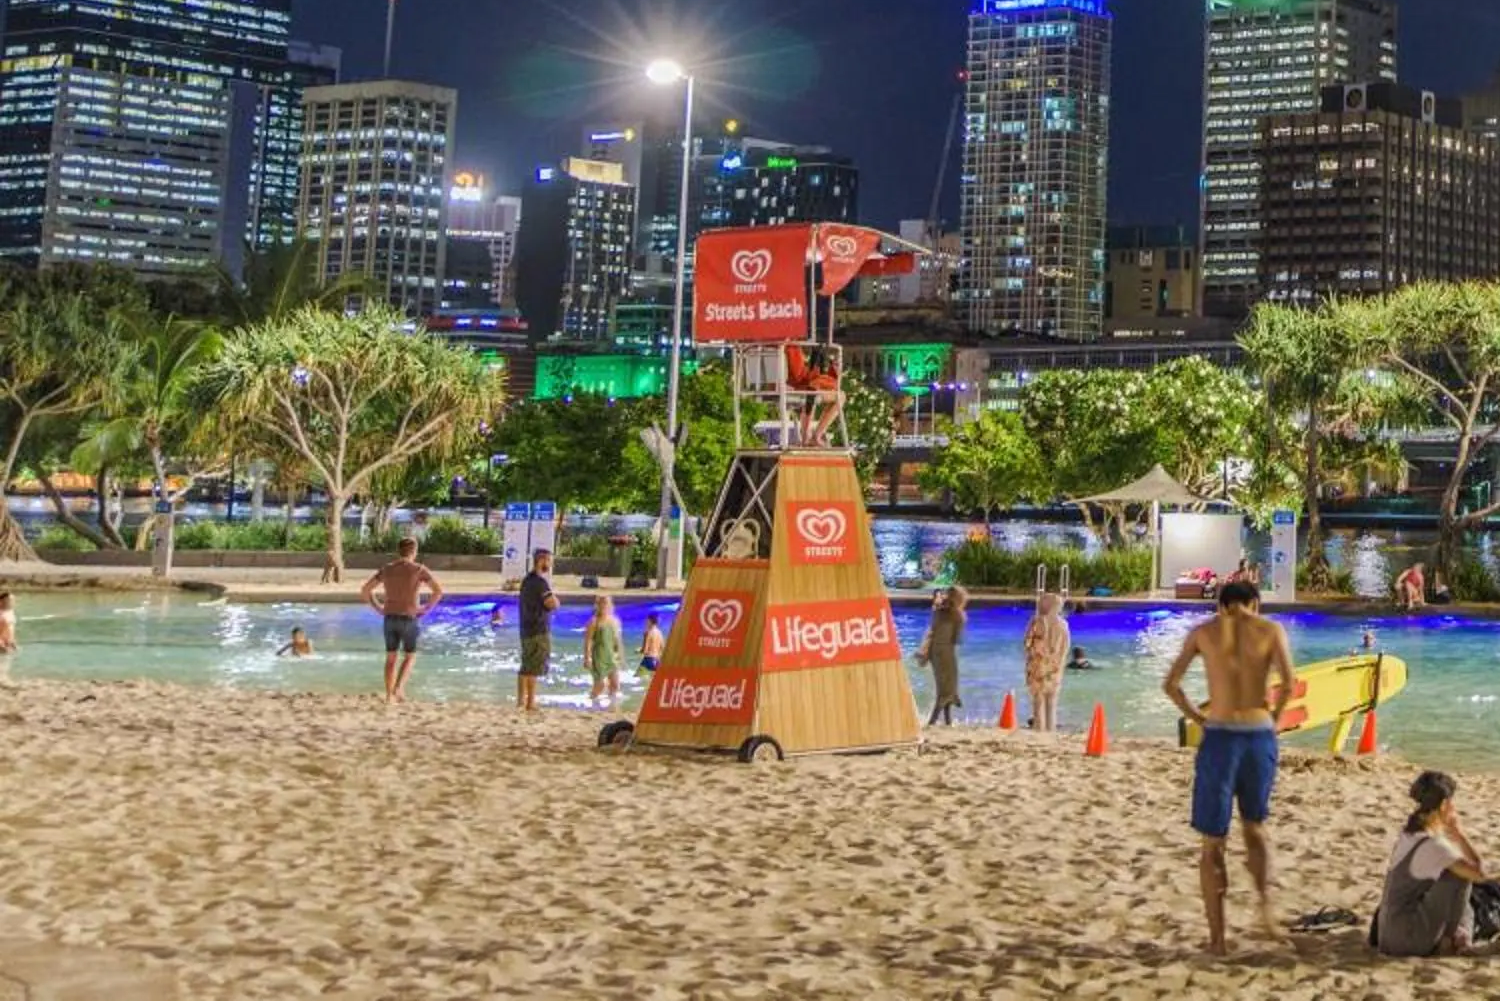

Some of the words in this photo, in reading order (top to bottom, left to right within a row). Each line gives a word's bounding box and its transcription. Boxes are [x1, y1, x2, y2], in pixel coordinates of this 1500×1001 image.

[704, 300, 755, 322] Streets
[759, 298, 803, 320] Beach
[771, 608, 889, 659] Lifeguard
[659, 678, 747, 718] Lifeguard
